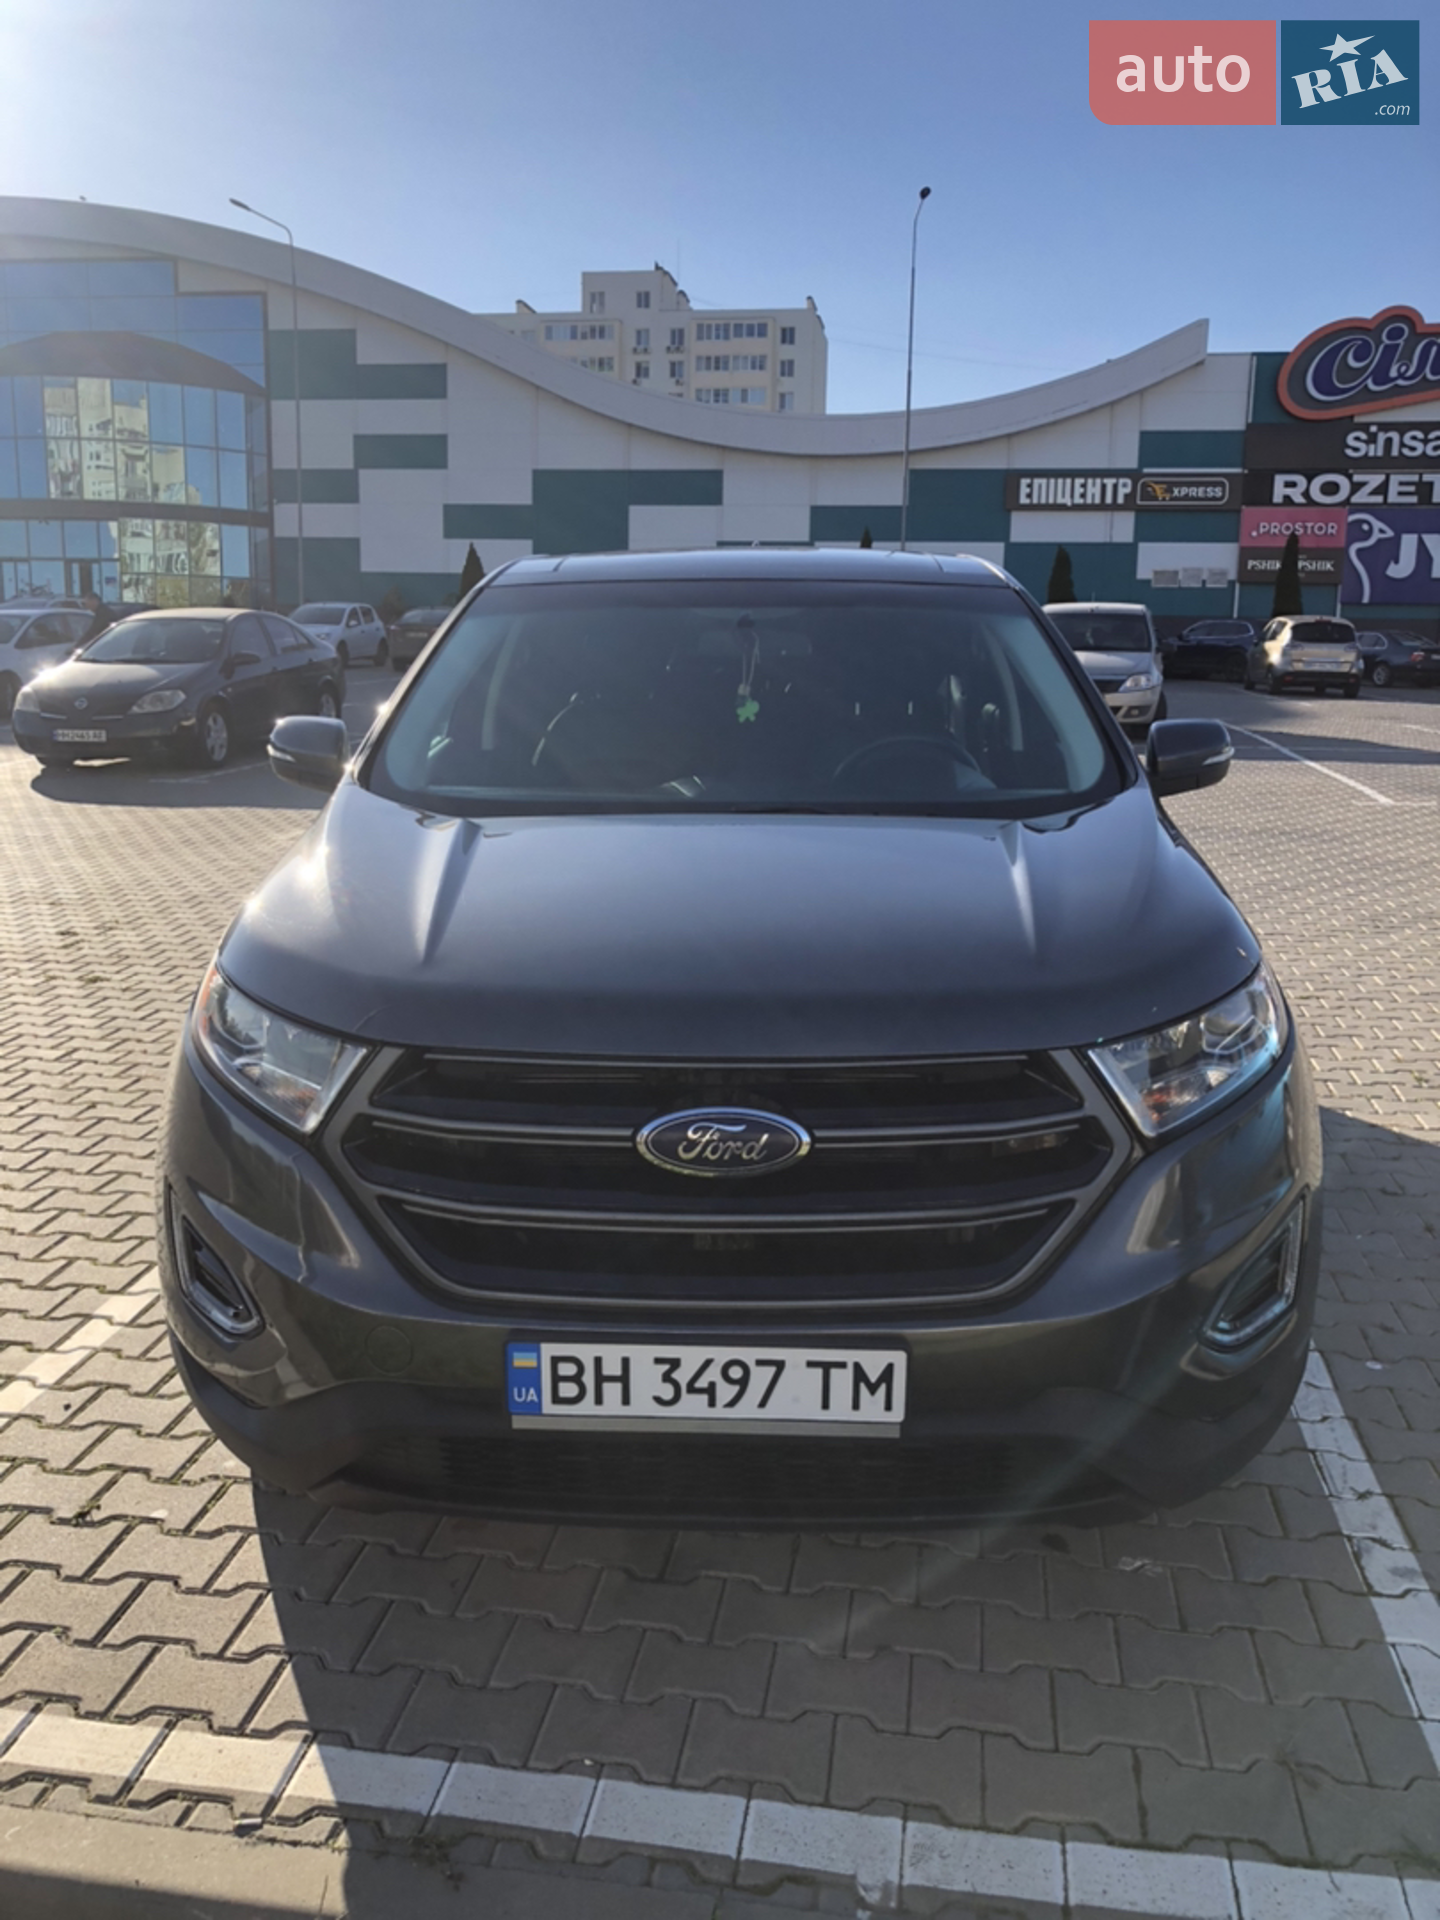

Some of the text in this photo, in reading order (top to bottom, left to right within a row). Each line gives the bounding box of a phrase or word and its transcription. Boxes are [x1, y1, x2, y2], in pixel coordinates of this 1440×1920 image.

[1019, 478, 1132, 506] ЕПІЦЕНТР
[1272, 473, 1440, 504] ROZET
[1297, 560, 1335, 571] PSHIK
[677, 1121, 769, 1161] Ford
[513, 1387, 538, 1403] UA
[549, 1355, 895, 1412] BH 3497 TM
